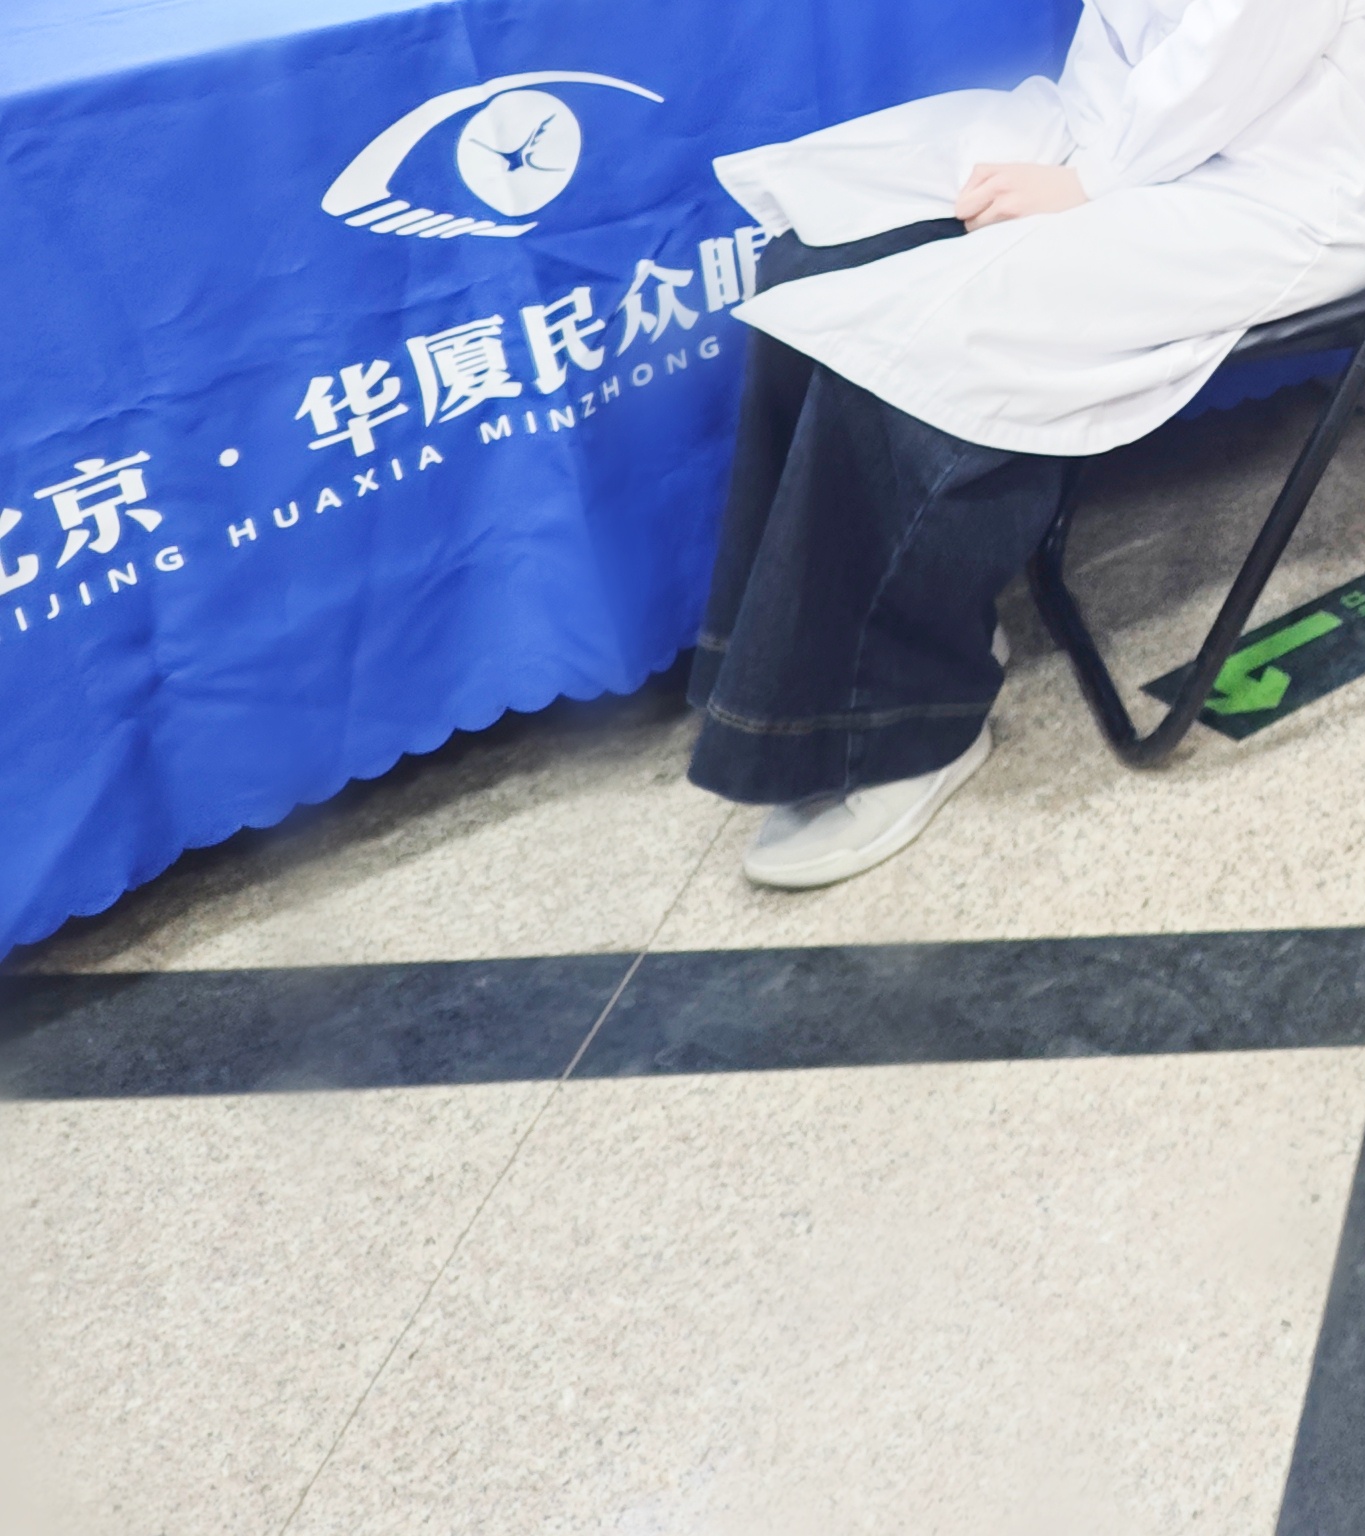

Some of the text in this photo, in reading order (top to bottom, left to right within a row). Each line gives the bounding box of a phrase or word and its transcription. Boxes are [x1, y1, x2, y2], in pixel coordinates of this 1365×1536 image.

[12, 335, 721, 632] IJING HUAXIA MINZHONG
